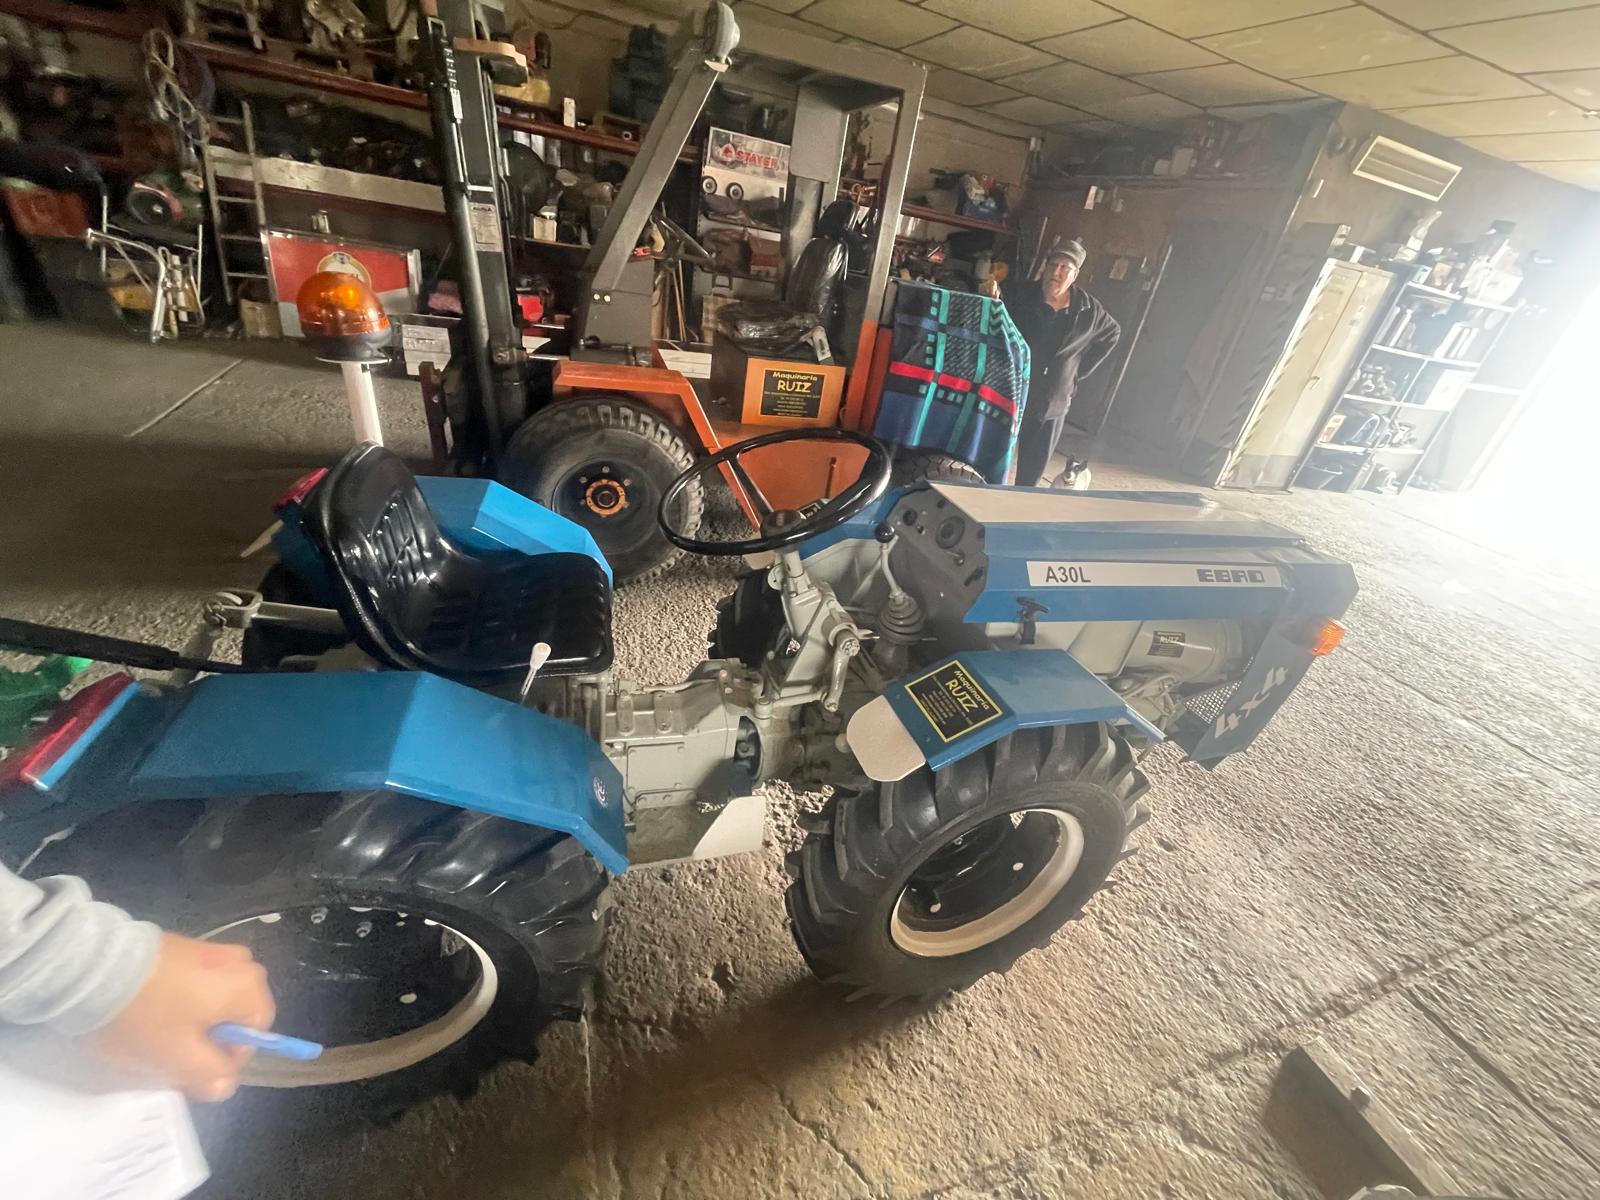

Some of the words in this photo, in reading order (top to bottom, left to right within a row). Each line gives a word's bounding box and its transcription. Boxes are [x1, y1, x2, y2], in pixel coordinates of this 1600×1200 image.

[735, 149, 779, 169] STAYER
[772, 371, 818, 381] Maquinaria
[777, 379, 812, 393] RUIZ
[1045, 565, 1092, 583] A30L
[945, 679, 979, 713] RUIZ
[953, 670, 990, 710] Maquinaria
